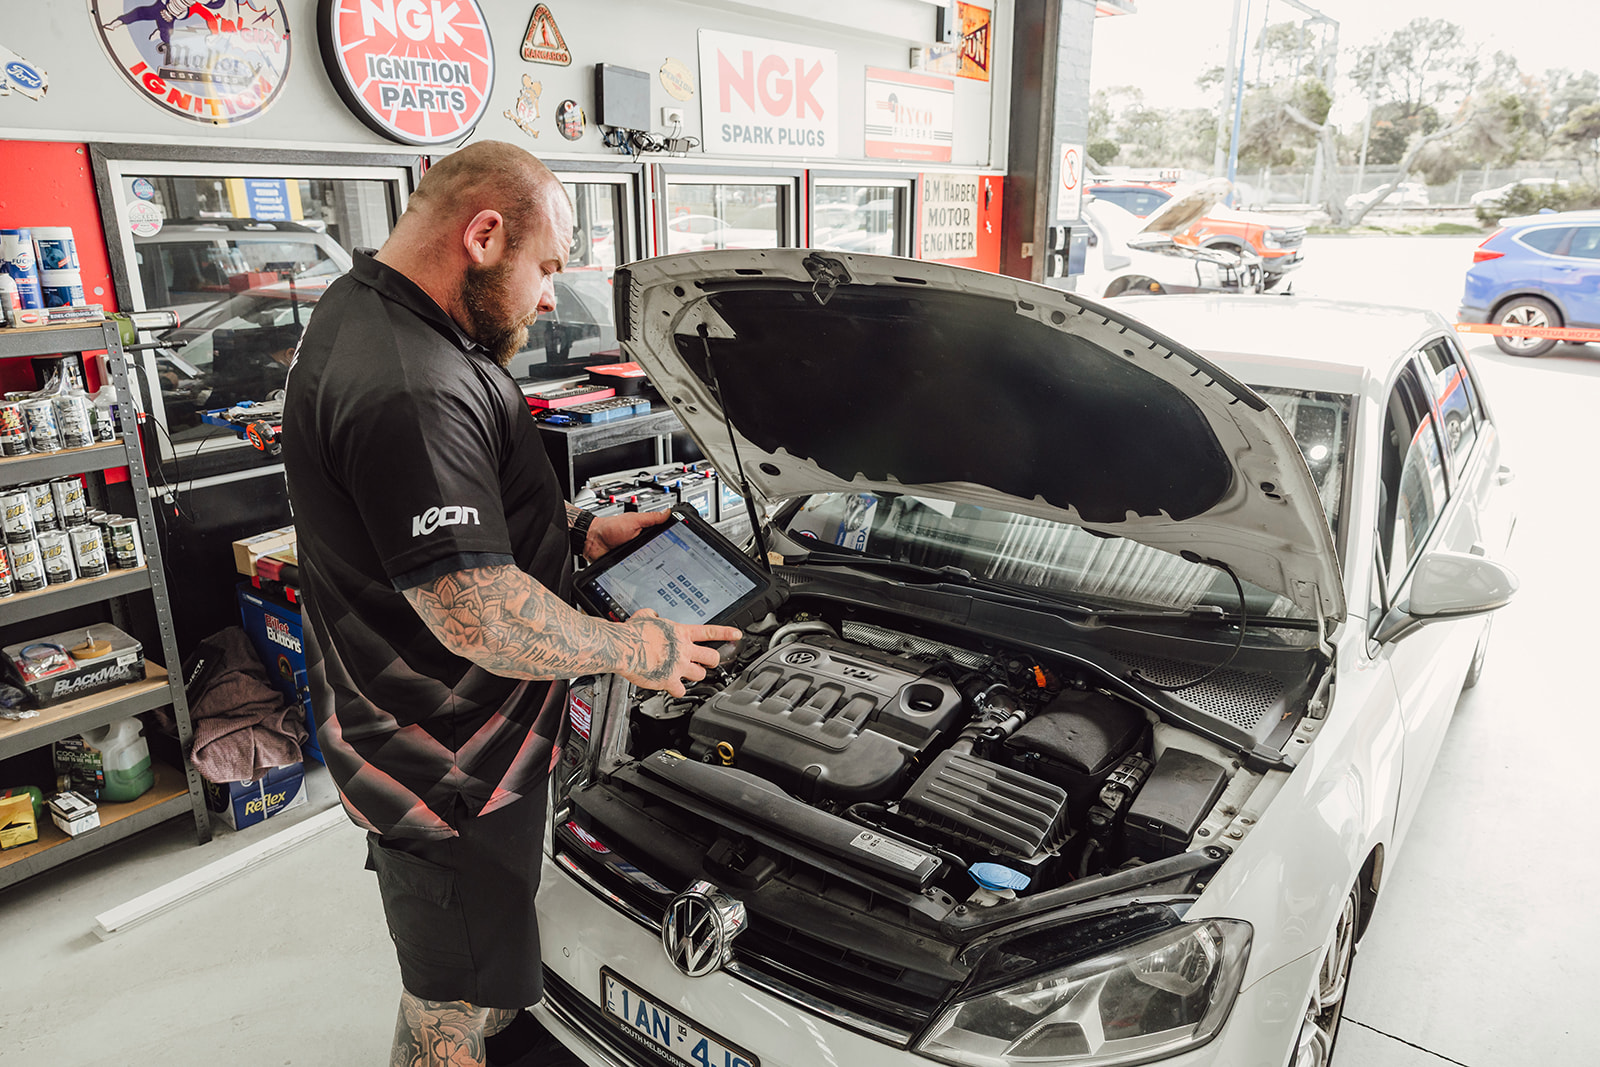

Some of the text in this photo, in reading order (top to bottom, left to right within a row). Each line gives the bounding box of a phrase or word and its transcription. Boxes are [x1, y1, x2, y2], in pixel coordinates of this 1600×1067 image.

[360, 0, 464, 47] NGK
[524, 48, 568, 63] KANGAROO
[7, 64, 41, 87] Ford
[368, 55, 470, 85] IGNITION
[130, 61, 272, 117] IGNITION
[717, 47, 825, 122] NGK
[381, 86, 466, 111] PARTS
[894, 103, 933, 126] RYCO
[722, 124, 825, 147] SPARK PLUGS
[927, 207, 971, 227] MOTOR
[923, 231, 975, 252] ENGINEER
[264, 613, 289, 635] Billet
[266, 627, 302, 654] Buttons
[843, 665, 879, 681] TDI
[56, 751, 95, 759] COOLANT
[245, 791, 287, 816] Reflex
[608, 979, 616, 1012] VIC
[620, 1023, 644, 1043] SOUTH
